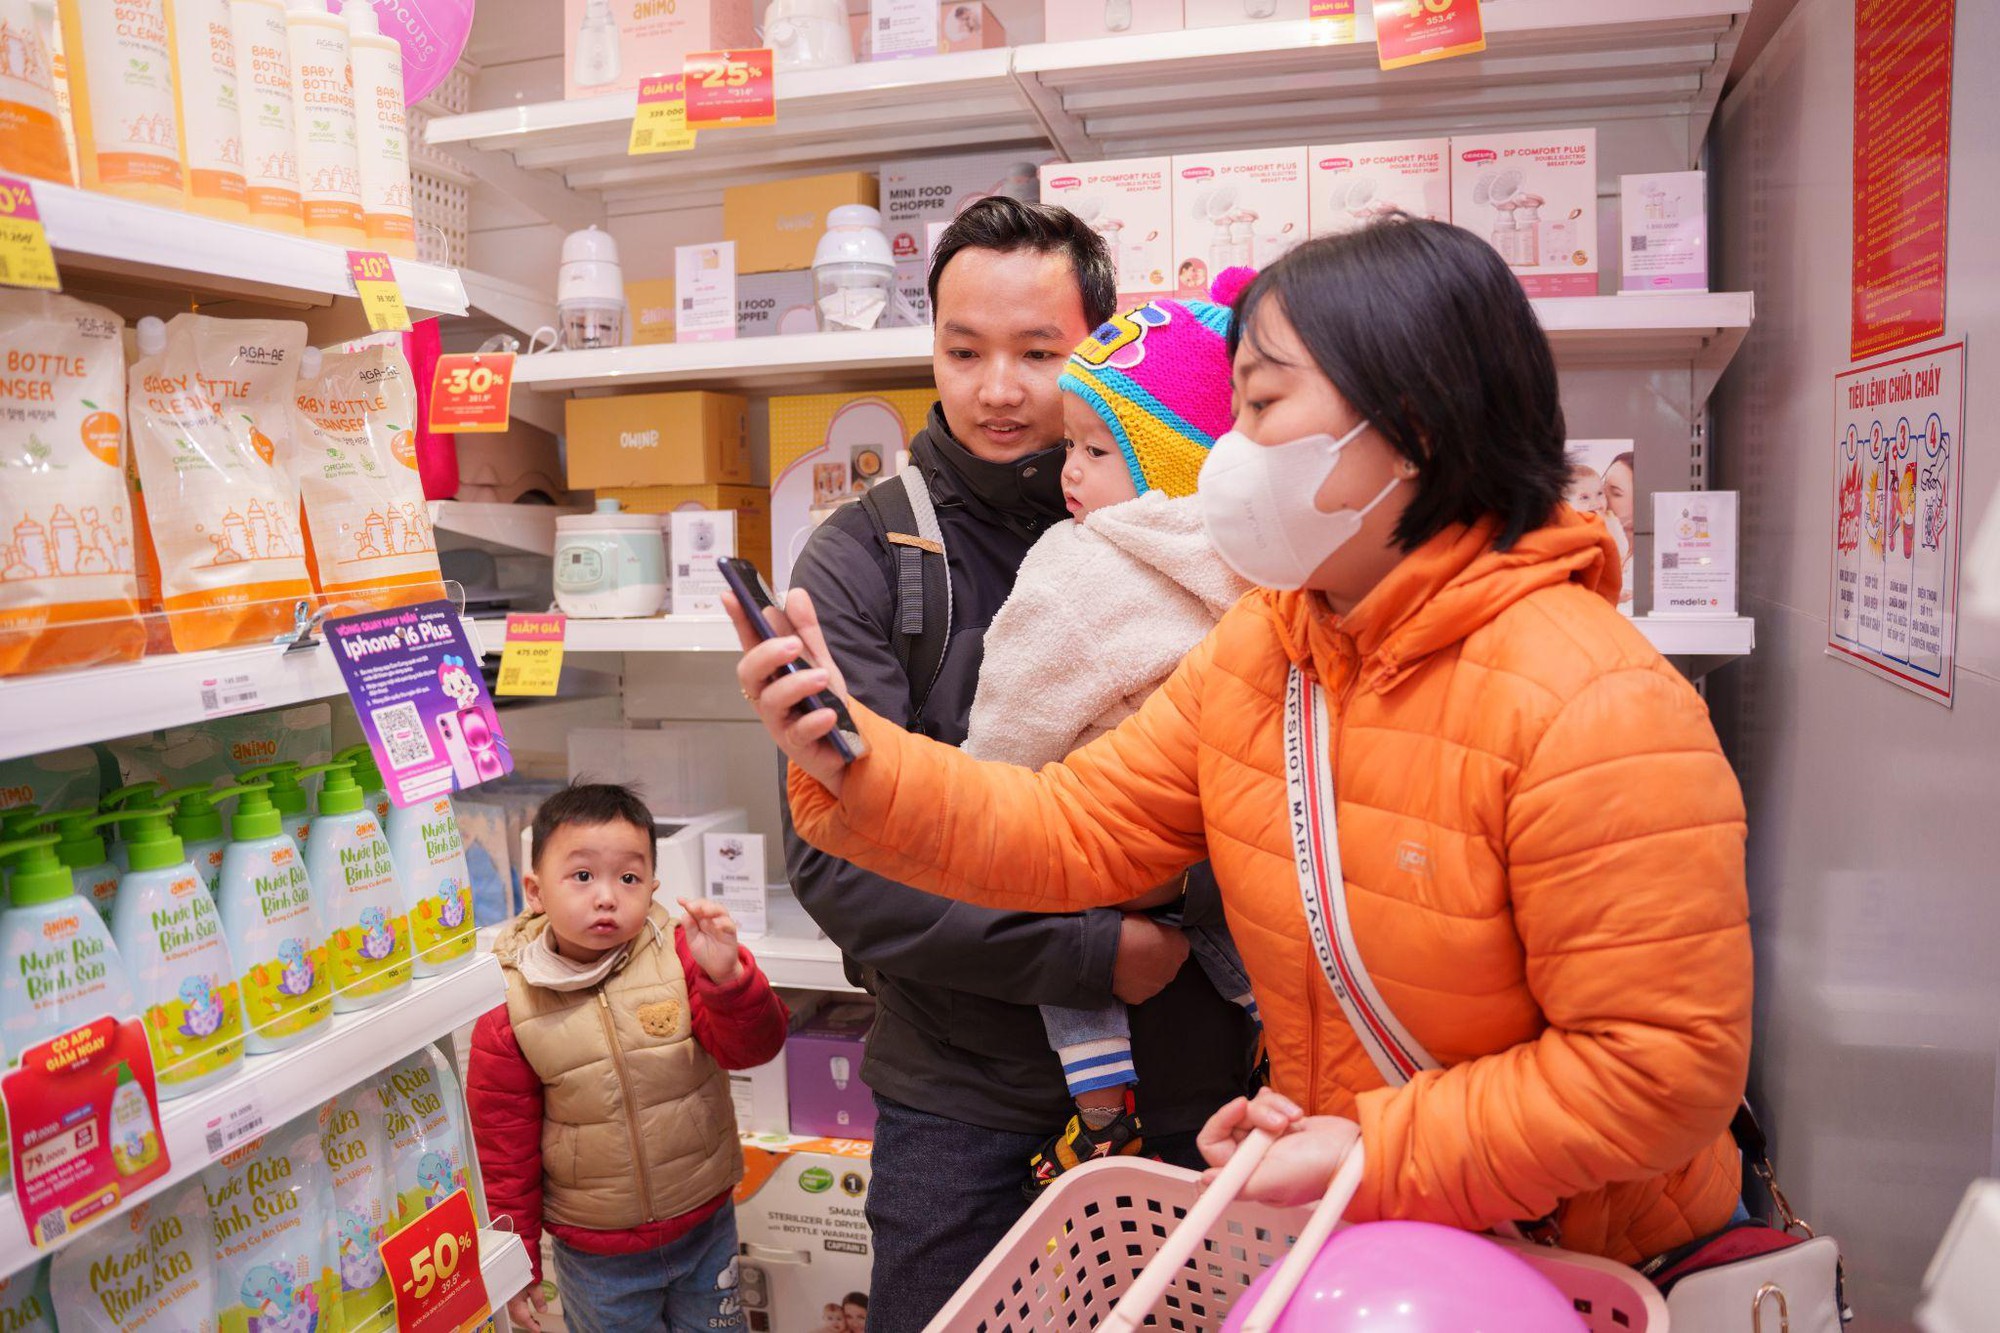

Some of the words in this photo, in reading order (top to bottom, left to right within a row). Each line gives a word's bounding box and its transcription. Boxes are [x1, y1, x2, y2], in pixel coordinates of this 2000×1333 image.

[301, 66, 334, 77] BABY
[693, 61, 762, 88] -25%
[1373, 155, 1415, 164] COMFORT
[1417, 153, 1439, 162] PLUS
[1503, 149, 1516, 157] DP
[1518, 146, 1560, 156] COMFORT
[1564, 144, 1586, 154] PLUS
[1234, 164, 1274, 173] COMFORT
[1277, 162, 1297, 170] PLUS
[1100, 173, 1140, 183] COMFORT
[890, 189, 916, 199] MINI
[919, 185, 953, 198] FOOD
[890, 199, 945, 212] CHOPPER
[353, 257, 390, 279] -10%
[745, 298, 776, 310] FOOD
[239, 346, 285, 361] AGA-AE
[7, 350, 87, 378] BOTTLE
[143, 374, 187, 394] BABY
[442, 367, 504, 394] -30%
[1866, 377, 1887, 411] LỆNH
[1889, 369, 1912, 404] CHỮA
[1915, 363, 1941, 399] CHÁY
[329, 397, 388, 415] BOTTLE
[1850, 432, 1854, 454] 1
[1873, 427, 1879, 452] 2
[1900, 425, 1906, 451] 3
[1929, 421, 1937, 449] 4
[510, 621, 539, 634] GIẢM
[541, 621, 560, 634] GIÁ
[341, 633, 401, 663] Iphone
[403, 625, 420, 646] 16
[418, 621, 452, 643] Plus
[1293, 801, 1310, 875] MARC
[1304, 888, 1346, 1001] JACOBS
[52, 1037, 70, 1054] CÓ
[71, 1028, 93, 1046] APP
[46, 1049, 79, 1072] GIẢM
[78, 1036, 106, 1057] NGAY
[247, 1156, 292, 1196] Rửa
[252, 1189, 298, 1223] Sữa
[768, 1211, 823, 1225] STERILIZER
[825, 1219, 832, 1227] &
[834, 1219, 867, 1230] DRYER
[783, 1226, 819, 1236] BOTTLE
[822, 1230, 867, 1241] WARMER
[402, 1231, 472, 1299] -50%
